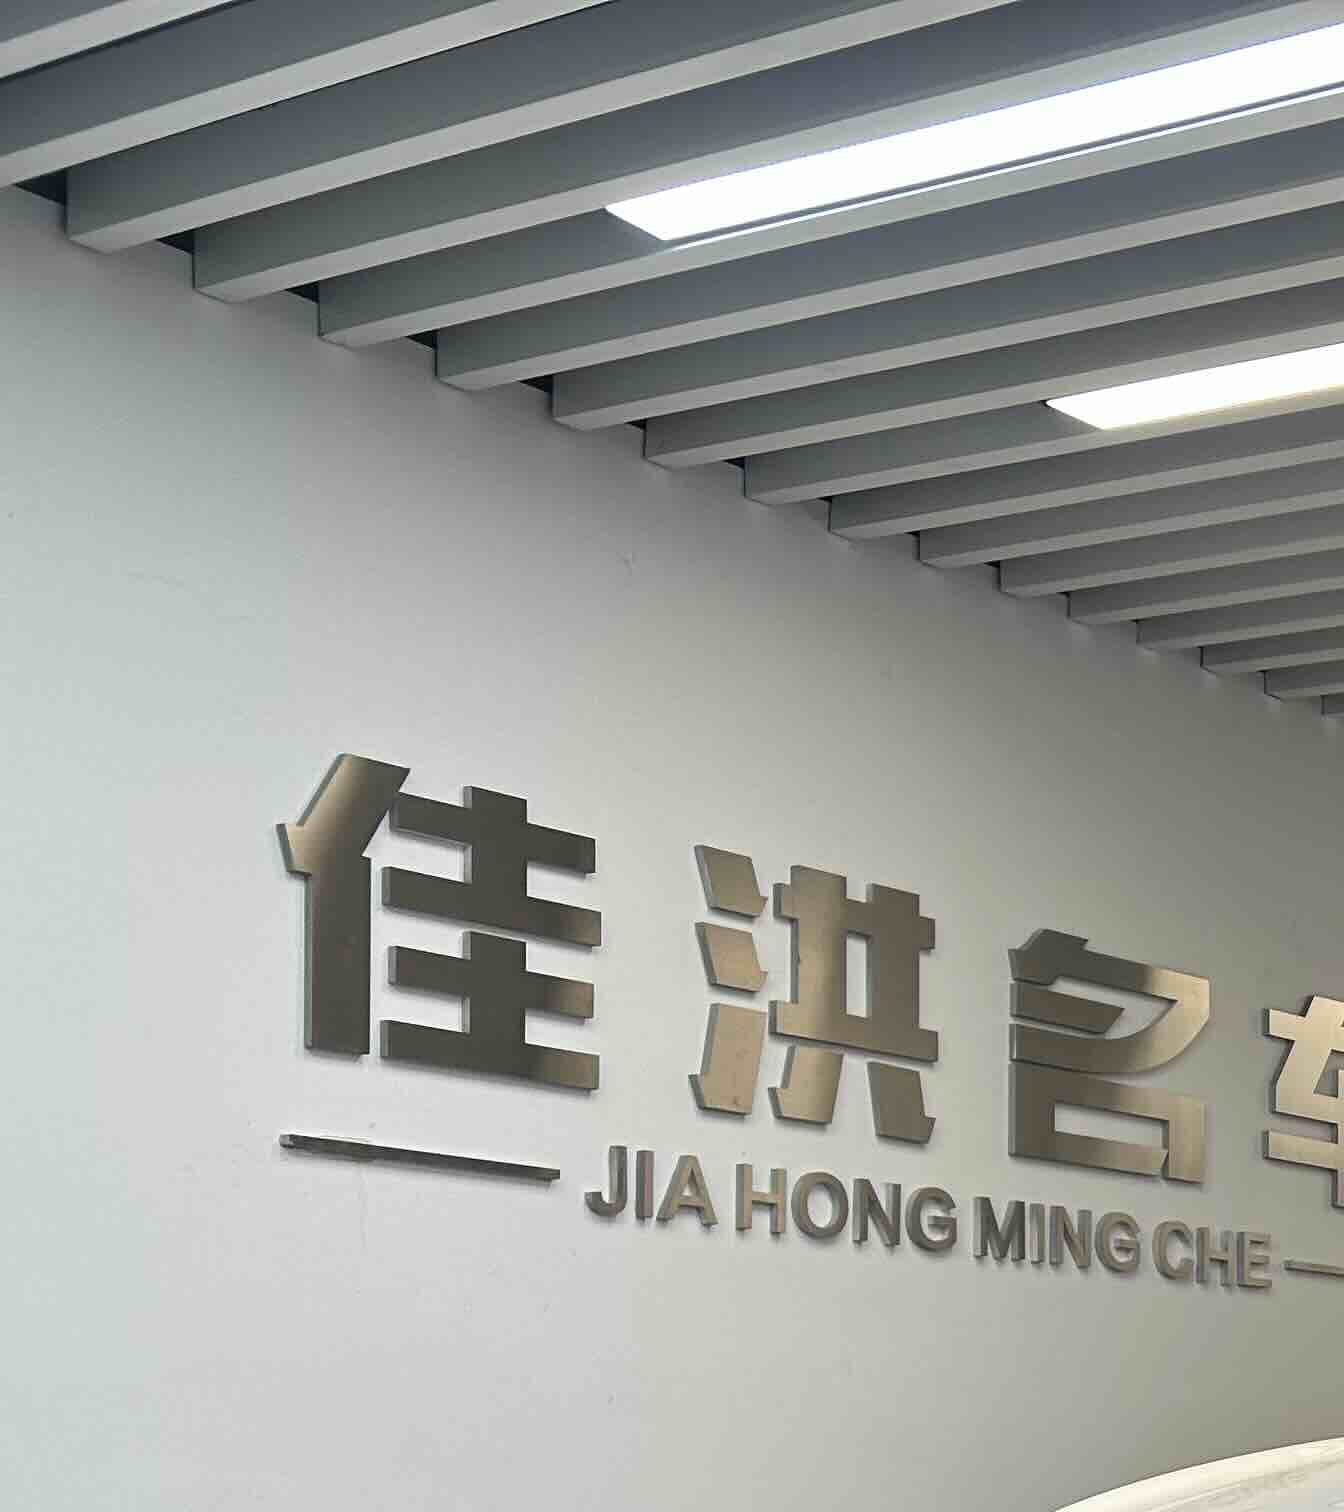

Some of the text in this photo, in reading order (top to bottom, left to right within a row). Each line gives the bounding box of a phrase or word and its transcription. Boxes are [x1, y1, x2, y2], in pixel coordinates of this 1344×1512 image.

[584, 1145, 1274, 1288] JIA HONG MING CHE
